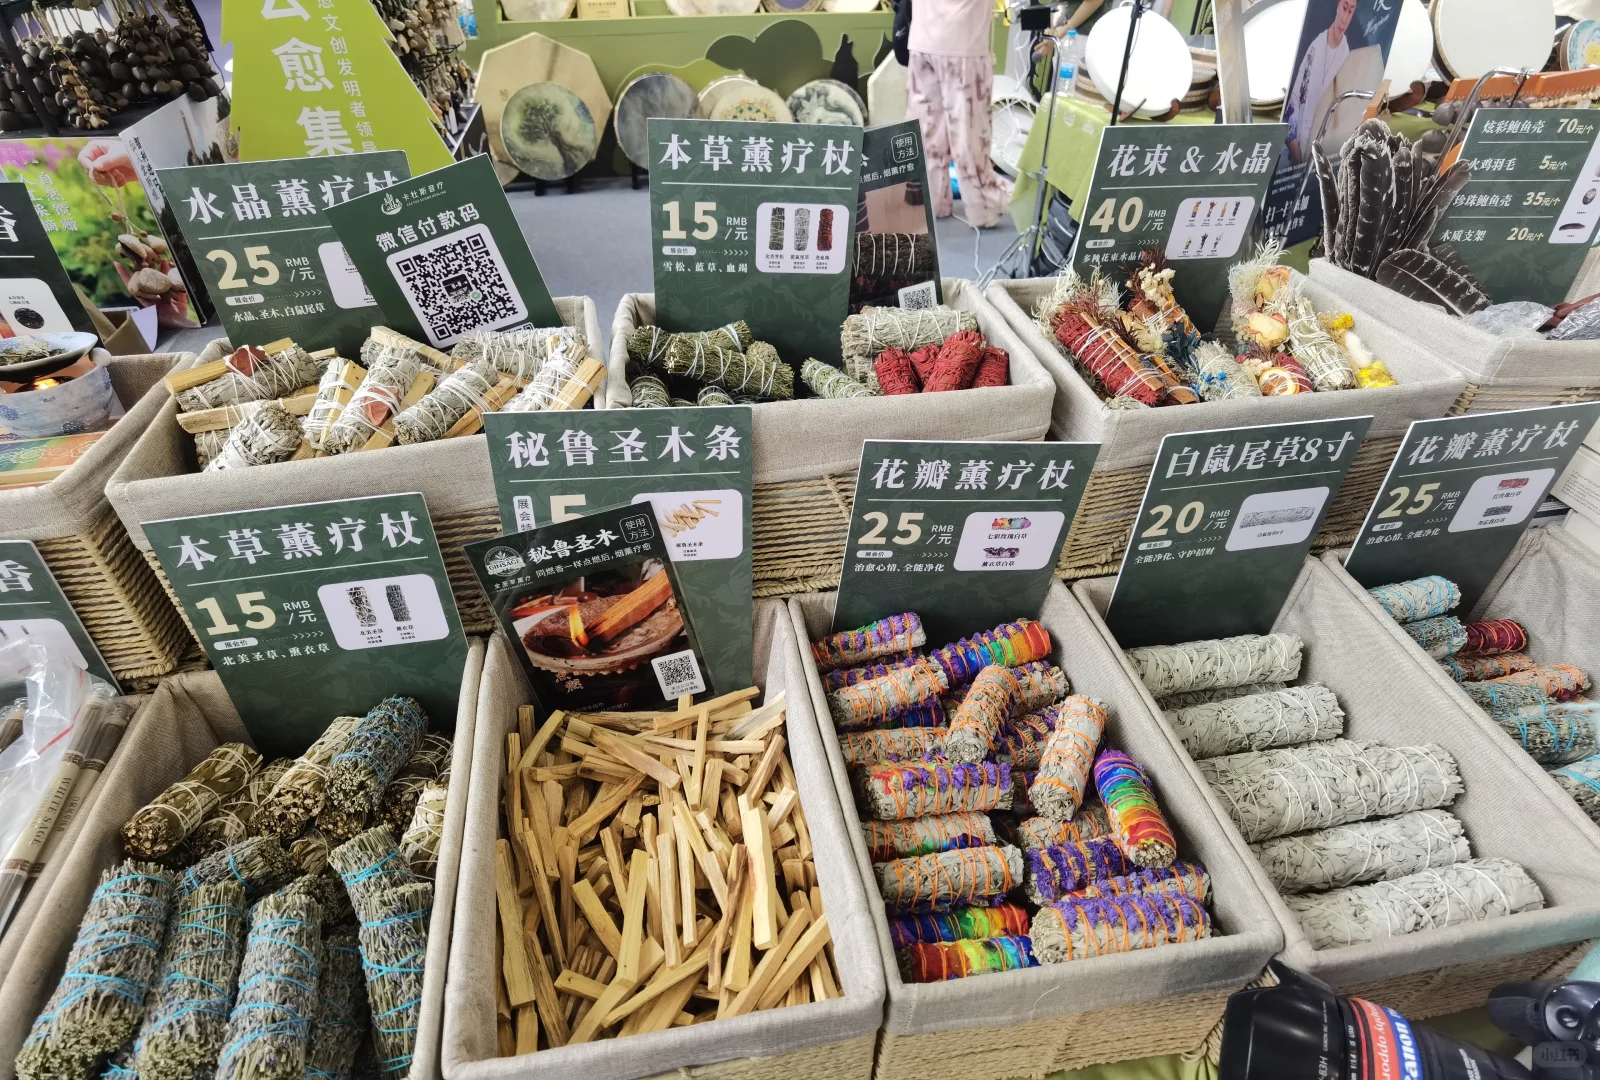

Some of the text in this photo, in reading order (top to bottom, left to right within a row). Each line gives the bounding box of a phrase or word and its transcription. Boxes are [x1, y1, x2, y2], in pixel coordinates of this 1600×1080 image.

[895, 136, 913, 148] 使用
[1481, 118, 1594, 134] 炫彩鲍鱼壳 70元/个
[658, 133, 855, 175] 本草薰疗杖
[897, 147, 915, 160] 方法
[1106, 141, 1272, 177] 花束 & 水晶
[1467, 155, 1568, 171] 火鸡羽毛 5元/个
[1089, 196, 1144, 233] 40
[1147, 210, 1167, 218] RMB
[1453, 192, 1561, 207] 珍珠鲍鱼壳 35元/个
[375, 203, 480, 253] 微信付款码
[662, 201, 718, 240] 15
[726, 216, 747, 226] RMB
[1440, 227, 1544, 242] 木质支架 20元/个
[205, 245, 280, 290] 25
[285, 257, 310, 268] RMB
[505, 424, 742, 469] 秘鲁圣木条
[1165, 431, 1355, 479] 白鼠尾草8寸
[1407, 419, 1579, 466] 花瓣薰疗杖
[870, 458, 1075, 490] 花瓣薰疗杖
[1377, 482, 1441, 519] 25
[1441, 490, 1461, 499] RMB
[625, 517, 646, 531] 使用
[857, 511, 925, 545] 25
[931, 524, 954, 533] RMB
[1141, 501, 1205, 538] 20
[1210, 509, 1231, 519] RMB
[168, 510, 424, 571] 本草薰疗杖
[527, 528, 620, 565] 秘鲁圣木
[629, 528, 650, 541] 方法
[195, 591, 276, 636] 15
[282, 599, 310, 612] RMB
[47, 777, 72, 814] WHITE
[31, 815, 52, 845] SAGE
[1377, 1035, 1390, 1080] oppor
